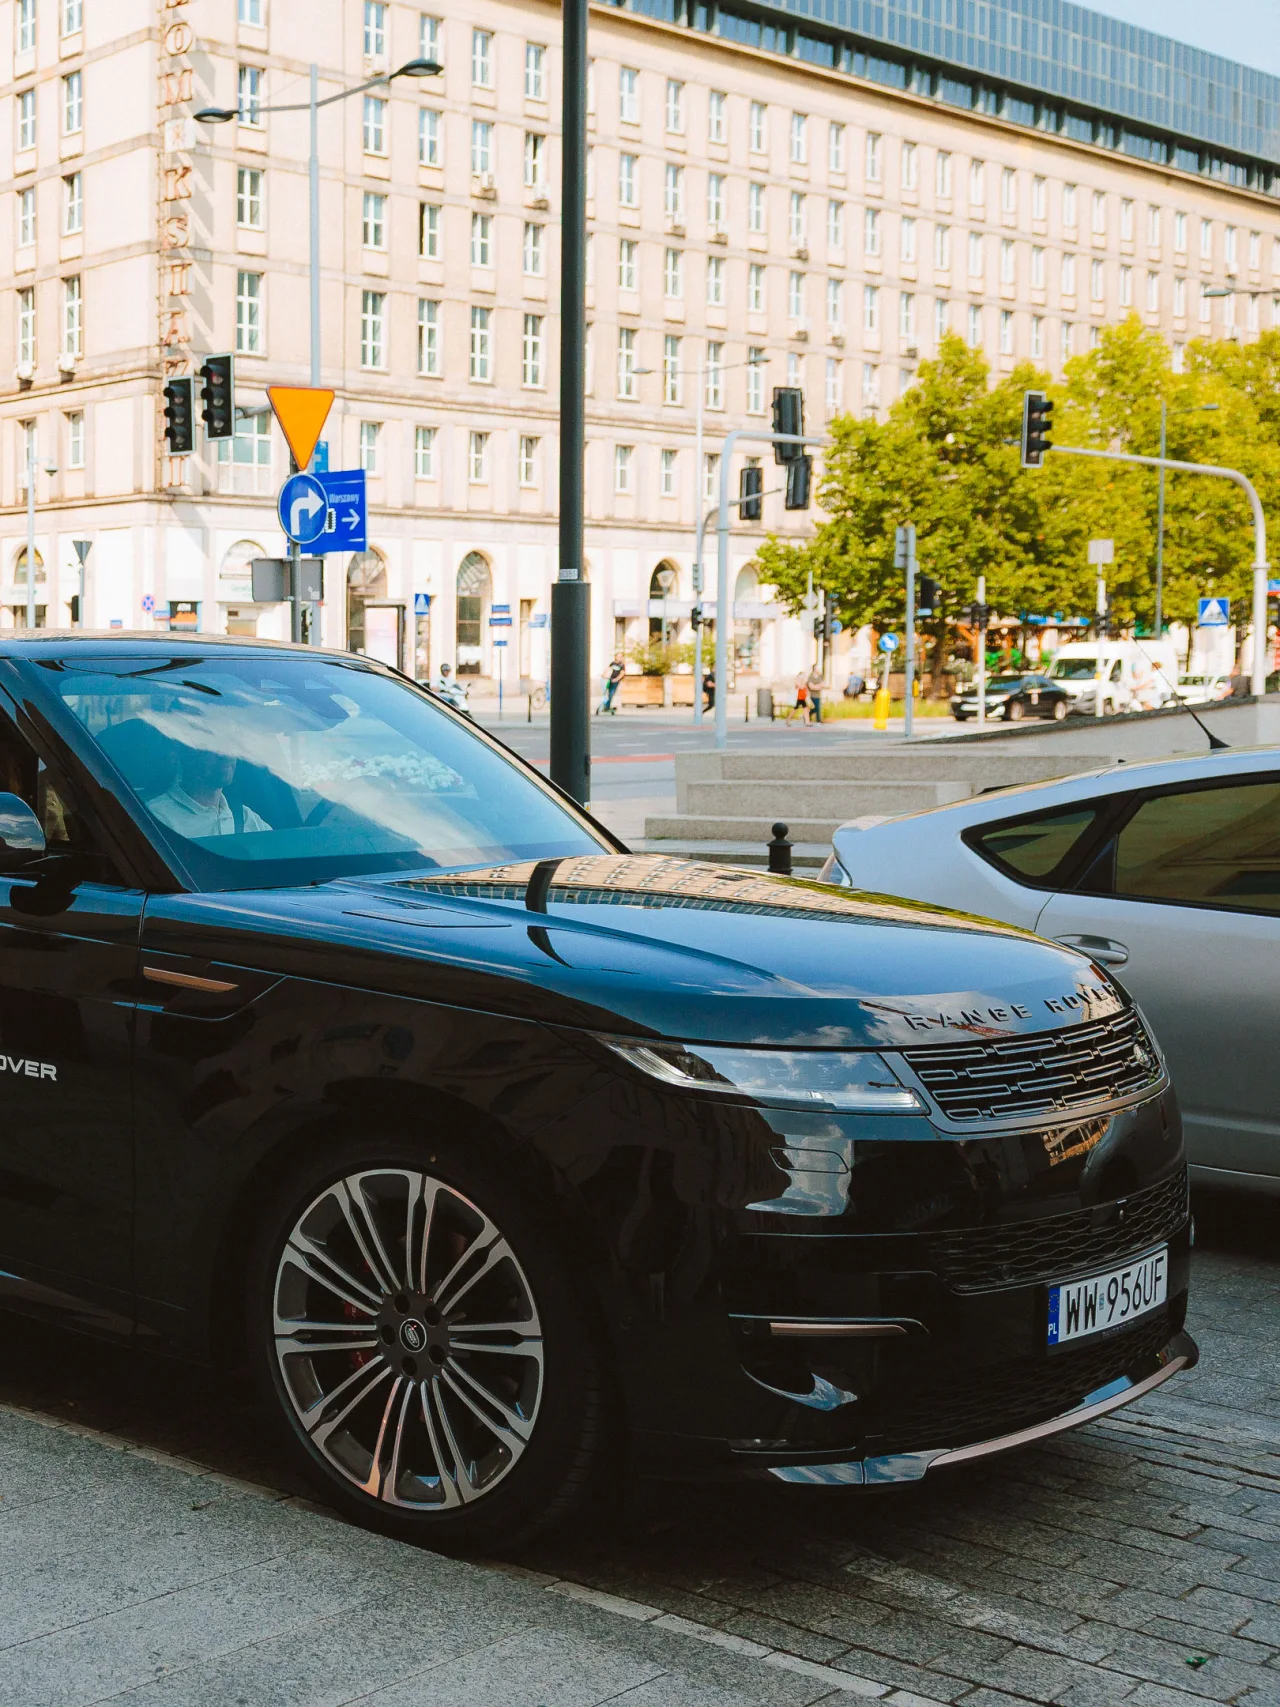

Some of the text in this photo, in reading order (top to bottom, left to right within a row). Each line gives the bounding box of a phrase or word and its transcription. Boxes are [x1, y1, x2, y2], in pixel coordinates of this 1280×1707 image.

[164, 0, 193, 105] OM
[904, 982, 1118, 1030] RANGE ROVER
[1048, 1323, 1057, 1336] PL
